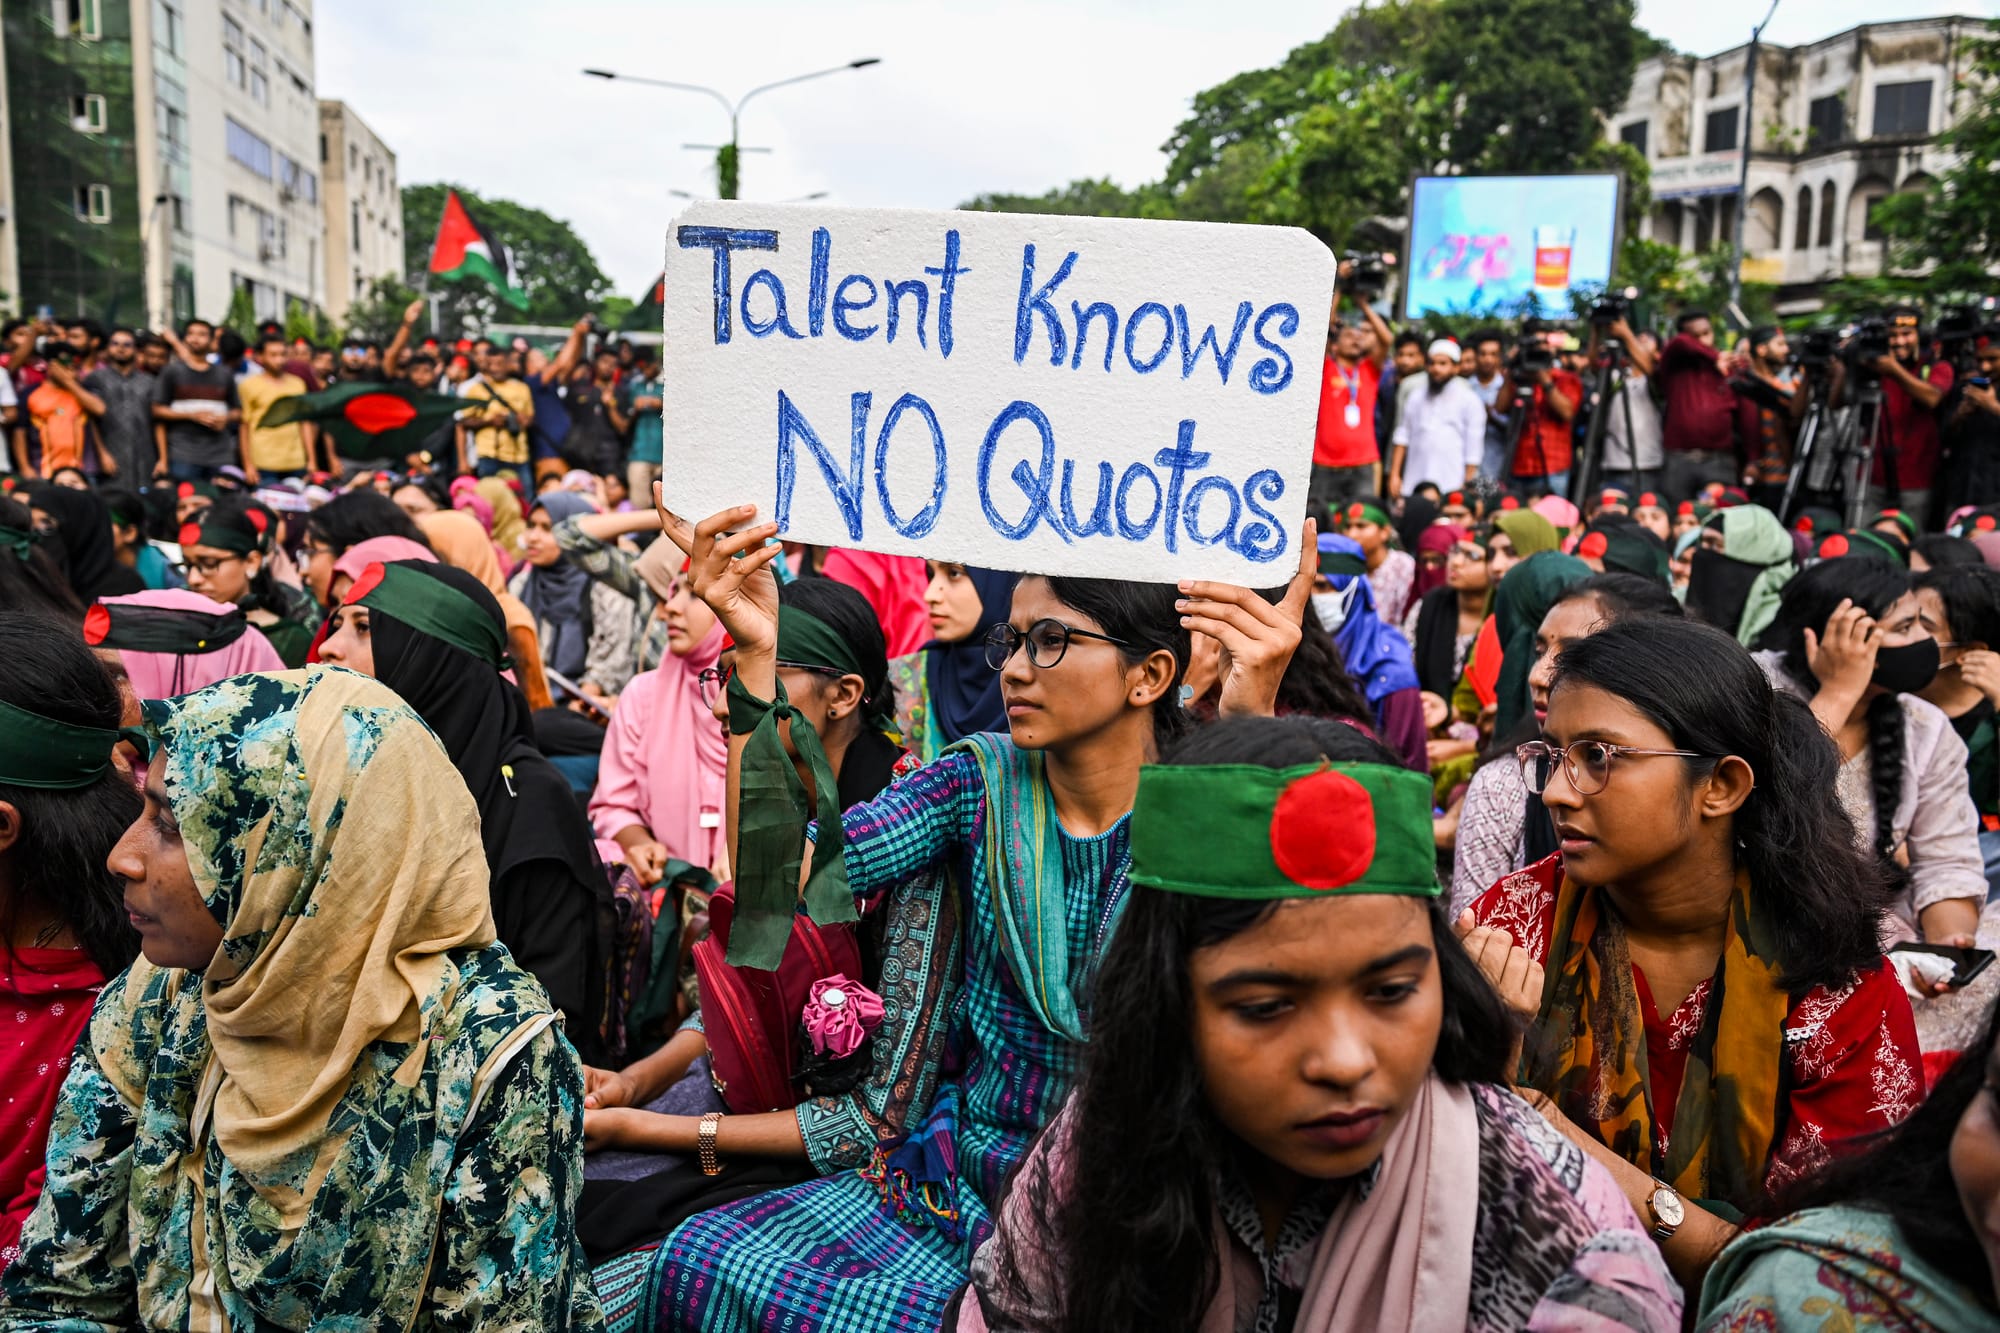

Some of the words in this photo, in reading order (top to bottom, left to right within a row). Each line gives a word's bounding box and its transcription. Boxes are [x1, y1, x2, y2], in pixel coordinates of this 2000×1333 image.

[677, 225, 972, 360] Talent
[1013, 243, 1300, 395] Knows
[775, 389, 948, 543] NO
[976, 399, 1289, 563] Quotas
